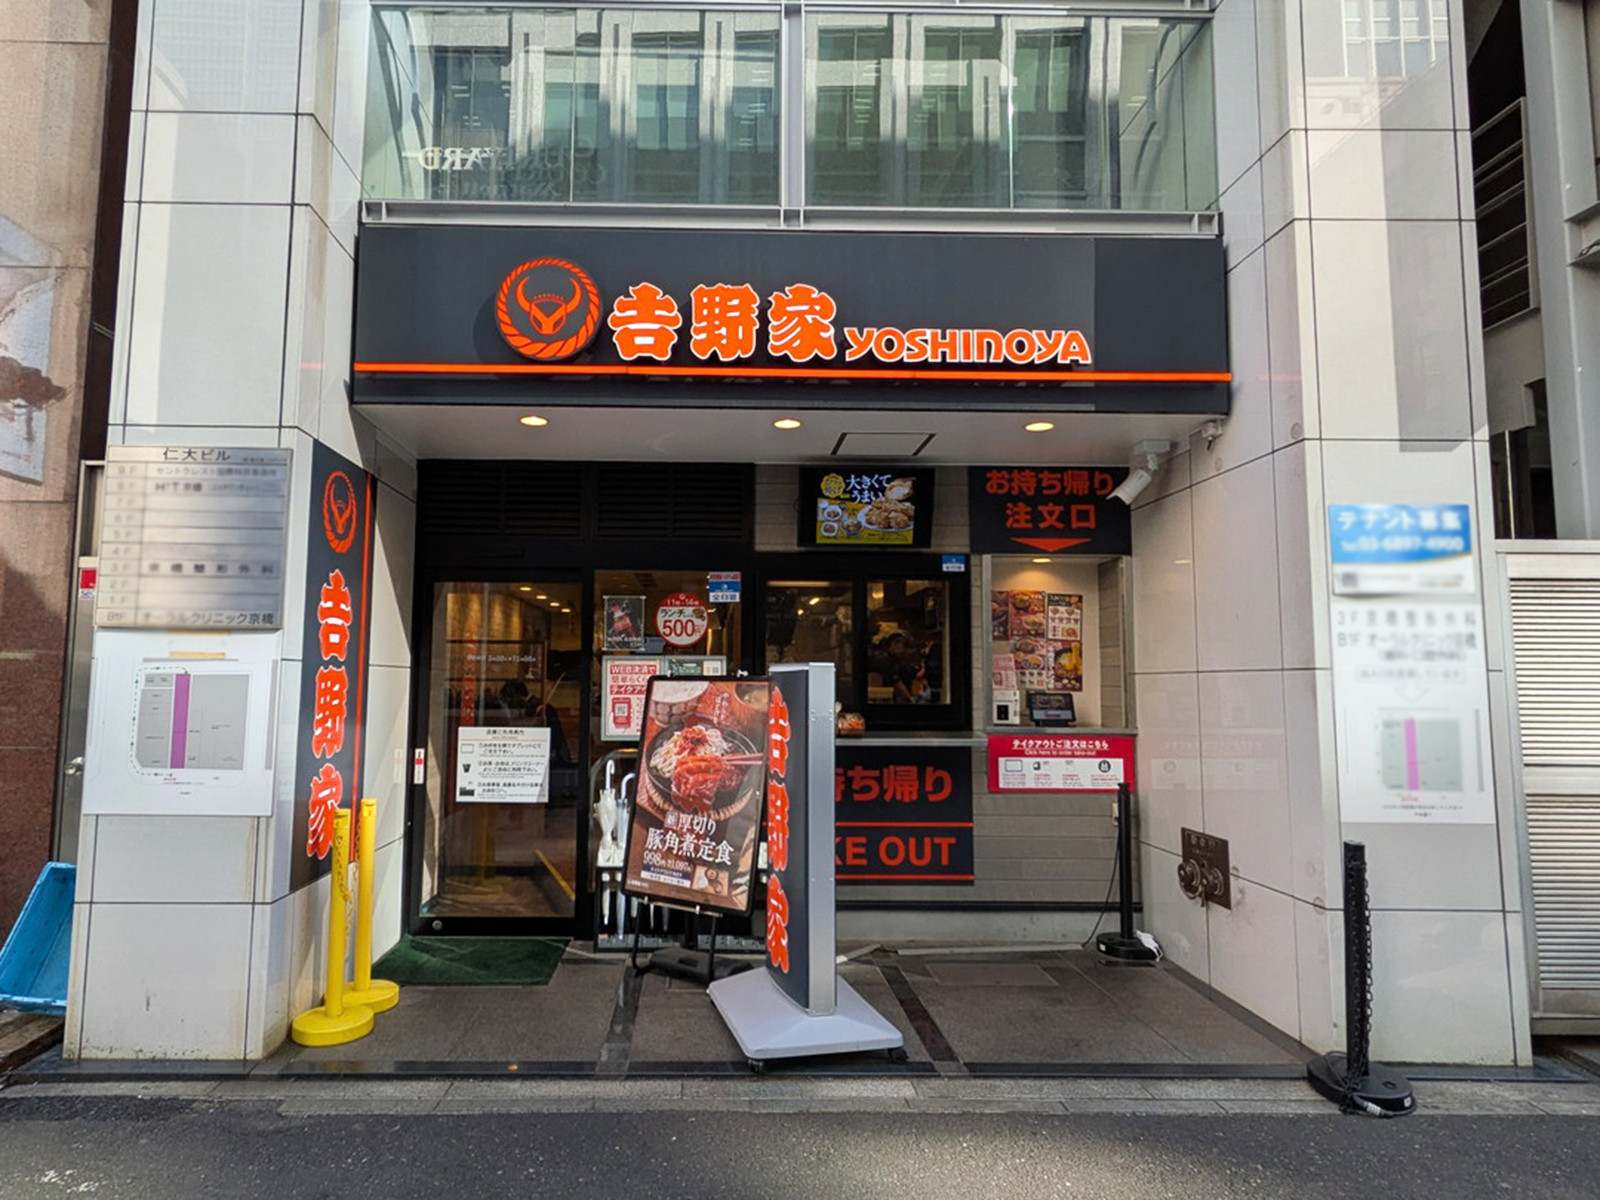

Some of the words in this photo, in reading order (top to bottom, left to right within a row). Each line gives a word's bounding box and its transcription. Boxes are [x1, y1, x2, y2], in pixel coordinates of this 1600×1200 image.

[608, 282, 838, 363] 吉野家
[843, 325, 1093, 365] YOSHINOYA
[163, 447, 232, 462] 仁大ビル
[845, 474, 892, 491] 大きくて
[985, 469, 1115, 496] お持ち帰り
[1005, 502, 1097, 529] 注文口
[678, 812, 717, 836] 厚切り
[645, 826, 735, 866] 豚角煮定食
[879, 836, 956, 867] OUT
